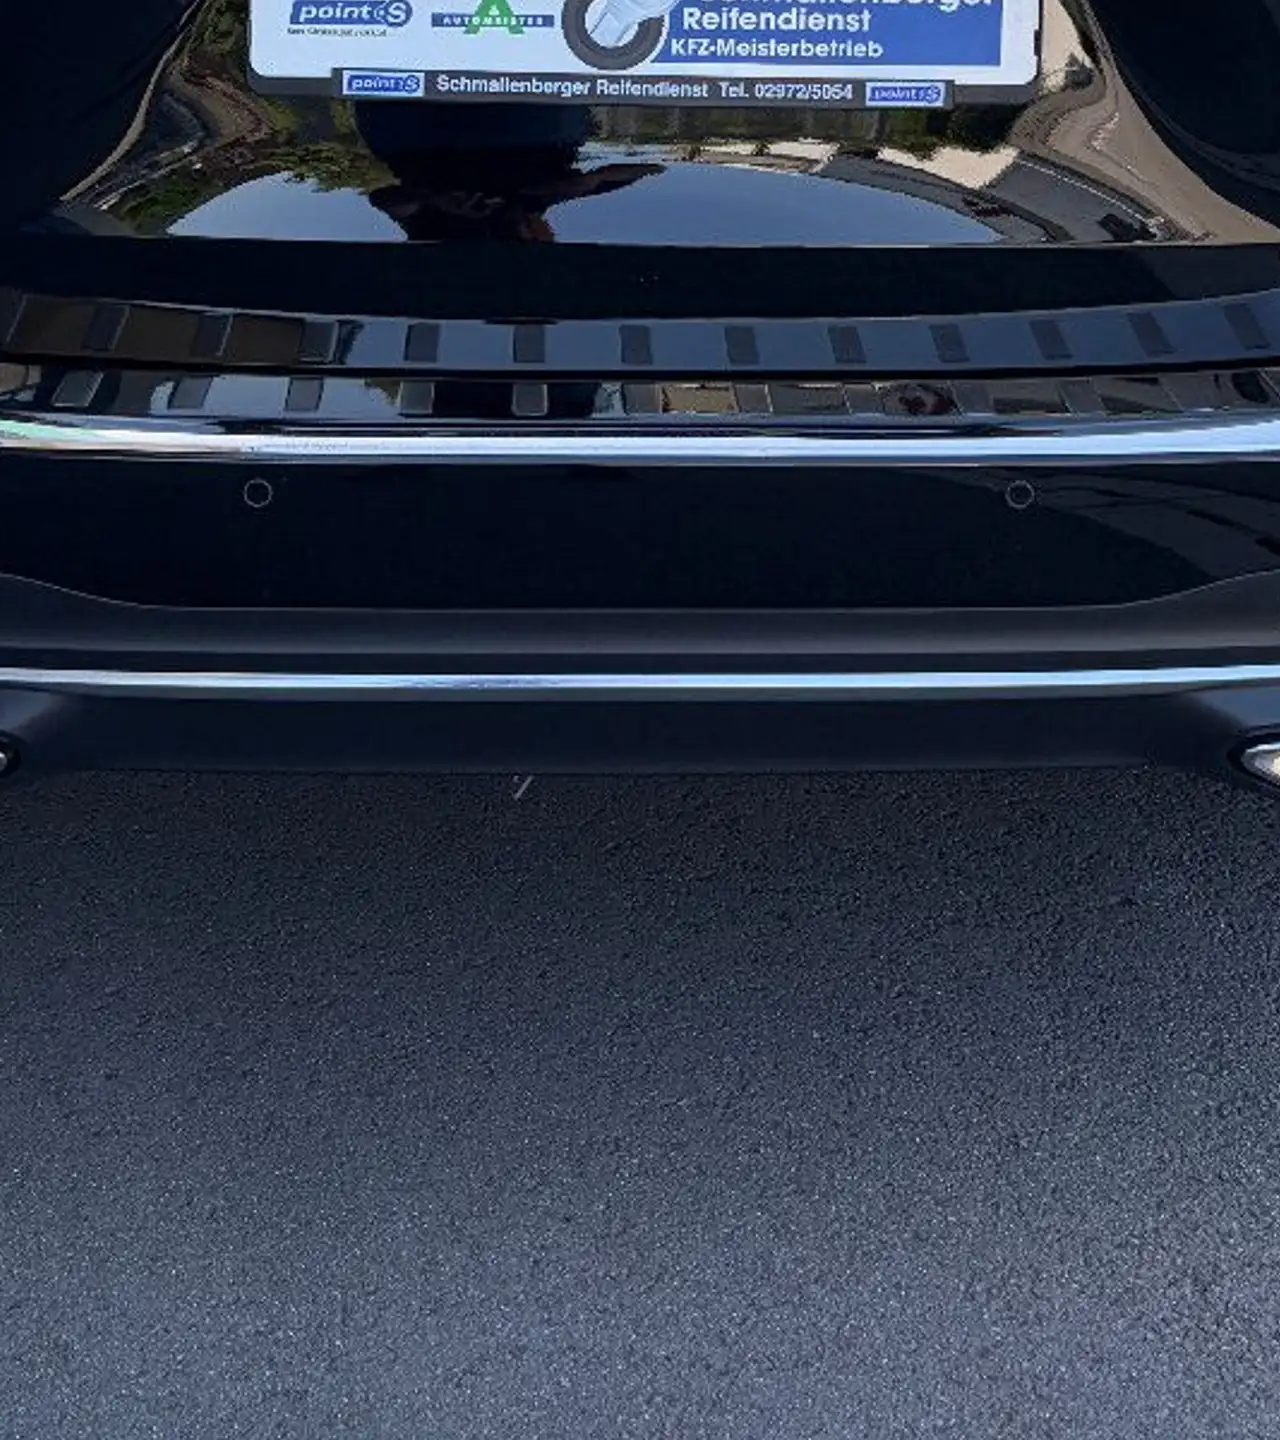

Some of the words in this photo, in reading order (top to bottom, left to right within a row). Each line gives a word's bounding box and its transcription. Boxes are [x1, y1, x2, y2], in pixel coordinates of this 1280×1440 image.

[299, 1, 372, 23] point
[682, 6, 872, 32] Reifendienst
[670, 37, 884, 59] KFZ-Meisterbetrieb
[436, 74, 591, 97] Schmallenberger
[596, 78, 709, 97] Reifendienst
[719, 80, 749, 98] Tel.
